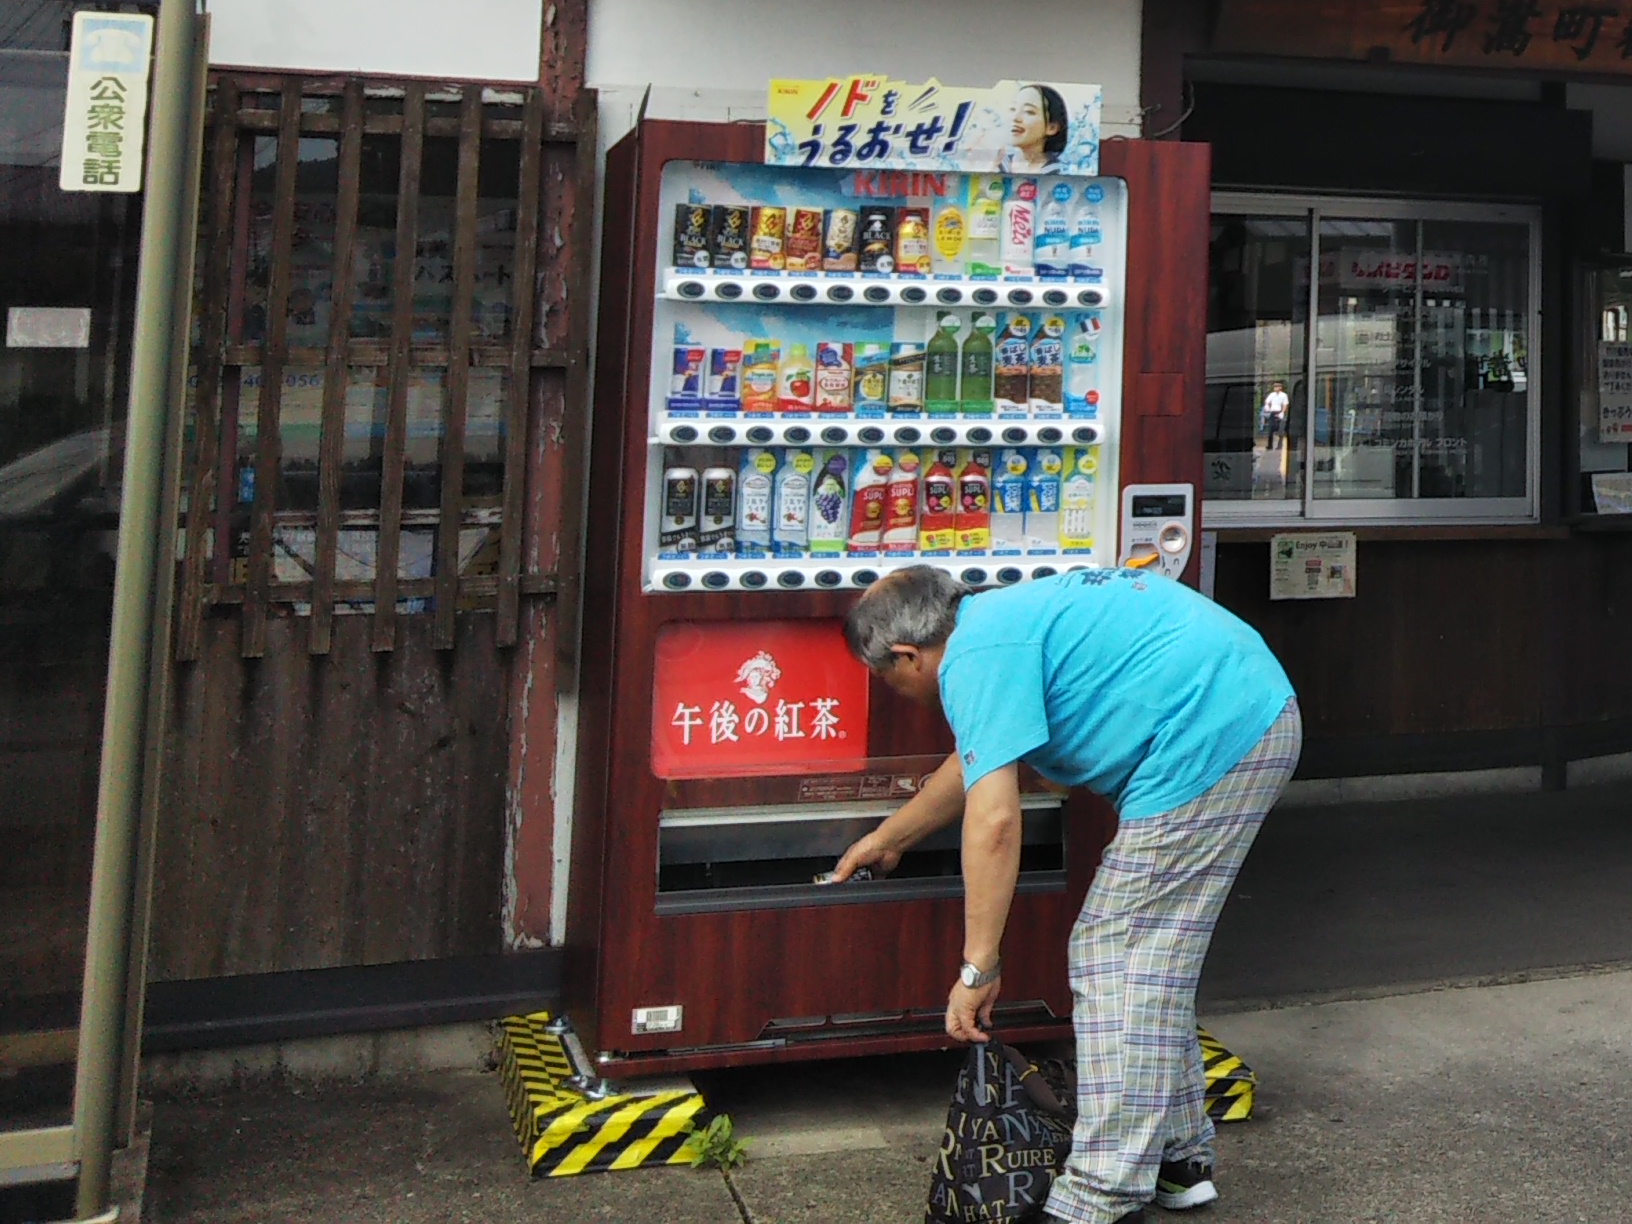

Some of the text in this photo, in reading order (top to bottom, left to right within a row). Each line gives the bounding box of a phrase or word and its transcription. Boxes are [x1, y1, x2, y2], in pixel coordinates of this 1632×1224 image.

[806, 79, 901, 121] ノドを
[82, 77, 127, 186] 公衆電話
[853, 171, 946, 198] KIRIN
[671, 697, 841, 746] 午後の紅茶
